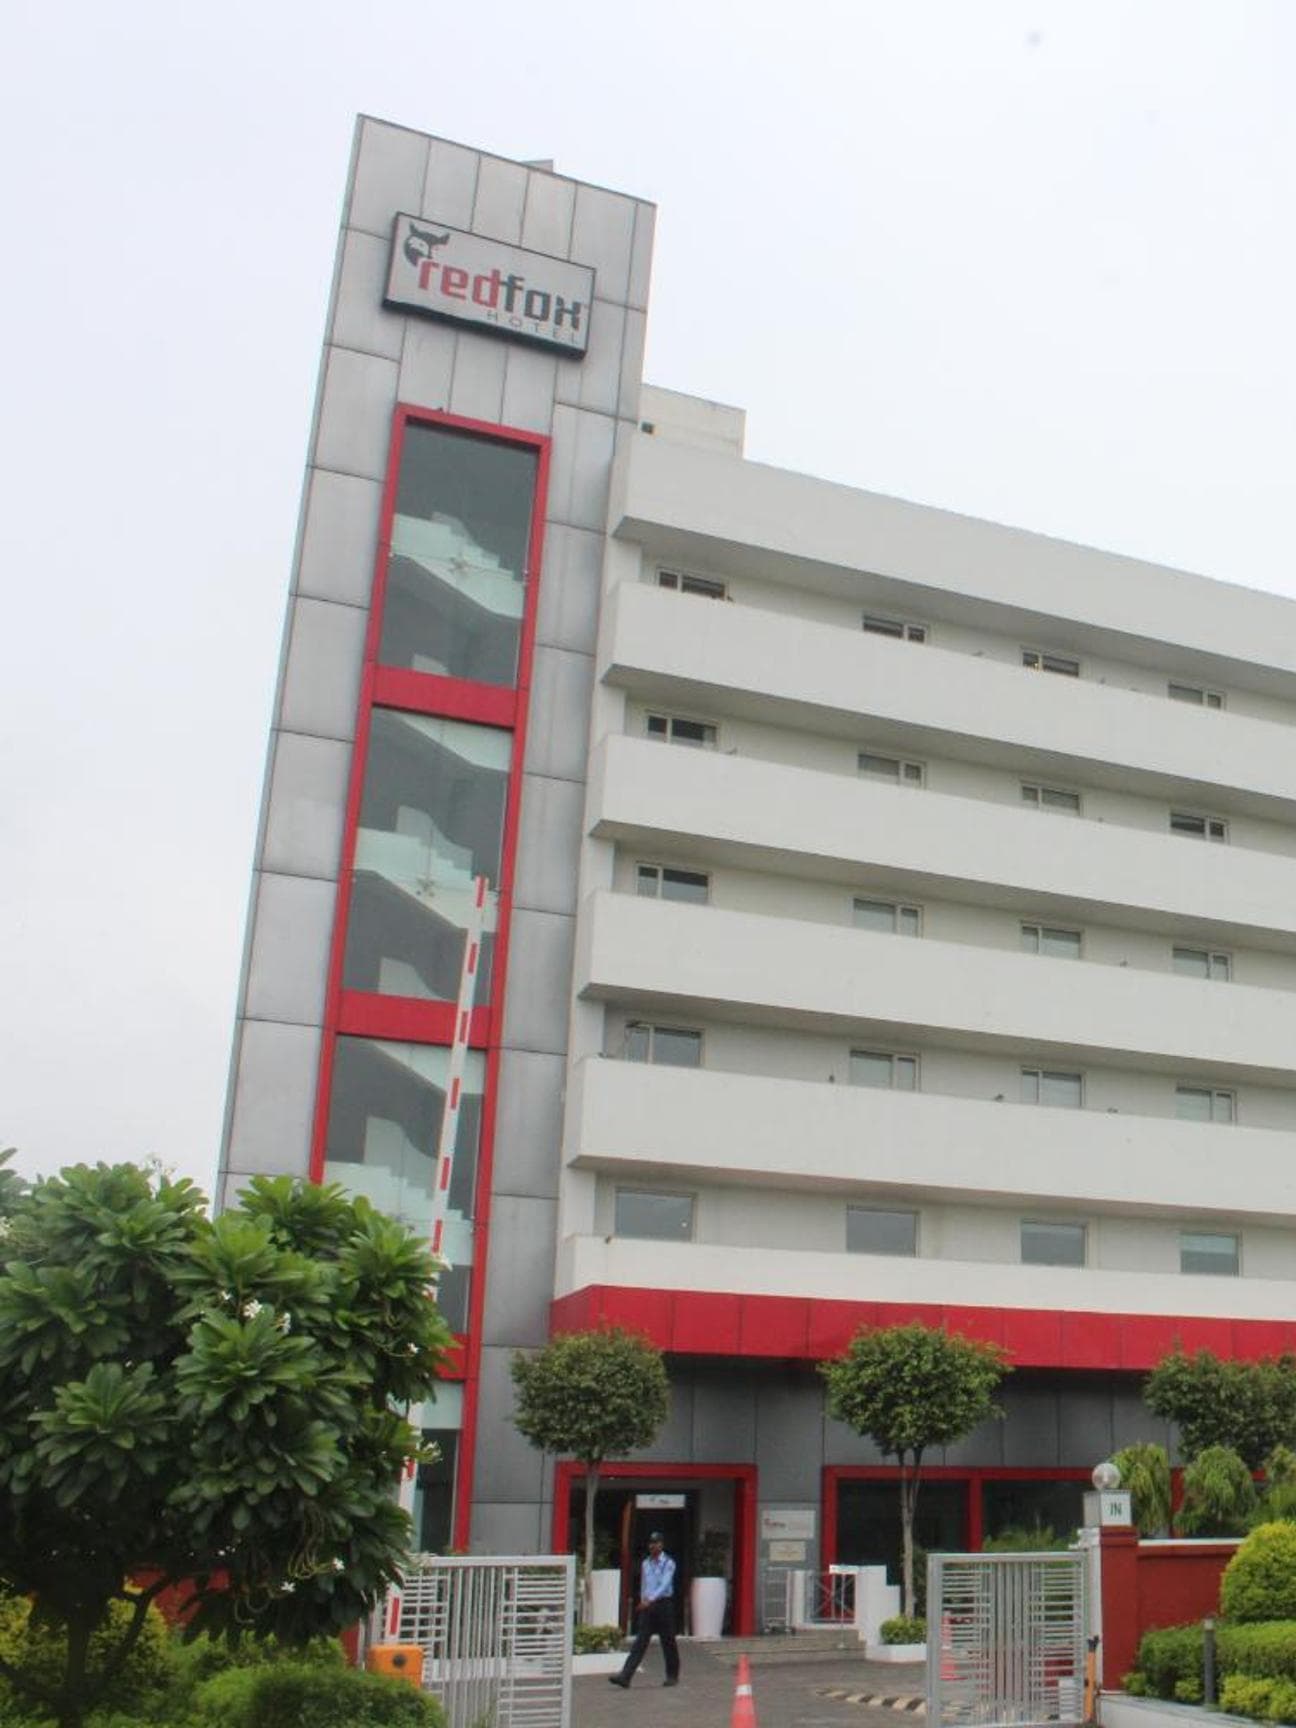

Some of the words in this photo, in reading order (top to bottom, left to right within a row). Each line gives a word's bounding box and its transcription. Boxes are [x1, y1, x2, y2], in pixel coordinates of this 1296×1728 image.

[418, 258, 582, 330] redfox
[487, 310, 578, 344] HOTEL
[1109, 1502, 1123, 1516] IN
